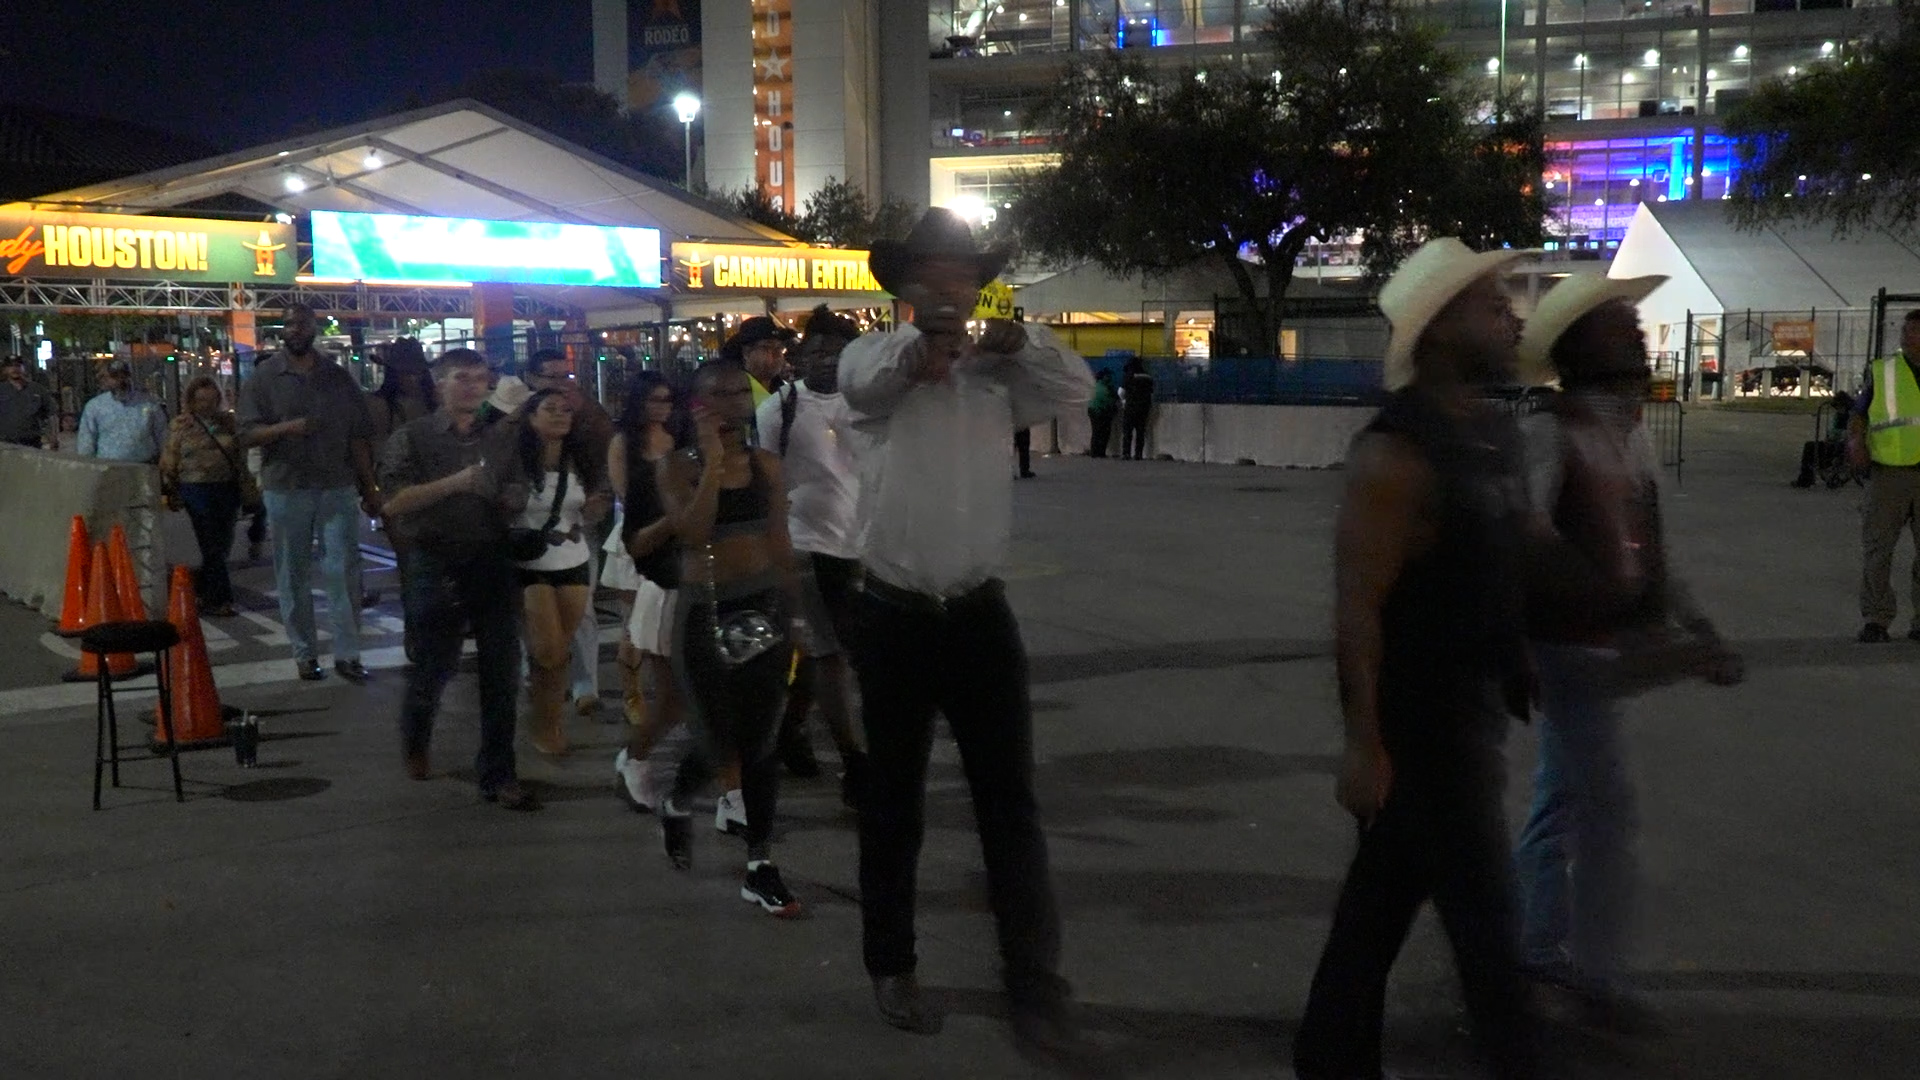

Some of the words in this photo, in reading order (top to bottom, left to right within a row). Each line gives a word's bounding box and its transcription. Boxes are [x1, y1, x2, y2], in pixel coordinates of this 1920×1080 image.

[644, 27, 689, 46] RODEO
[43, 225, 208, 271] HOUSTON!
[713, 254, 809, 289] CARNIVAL
